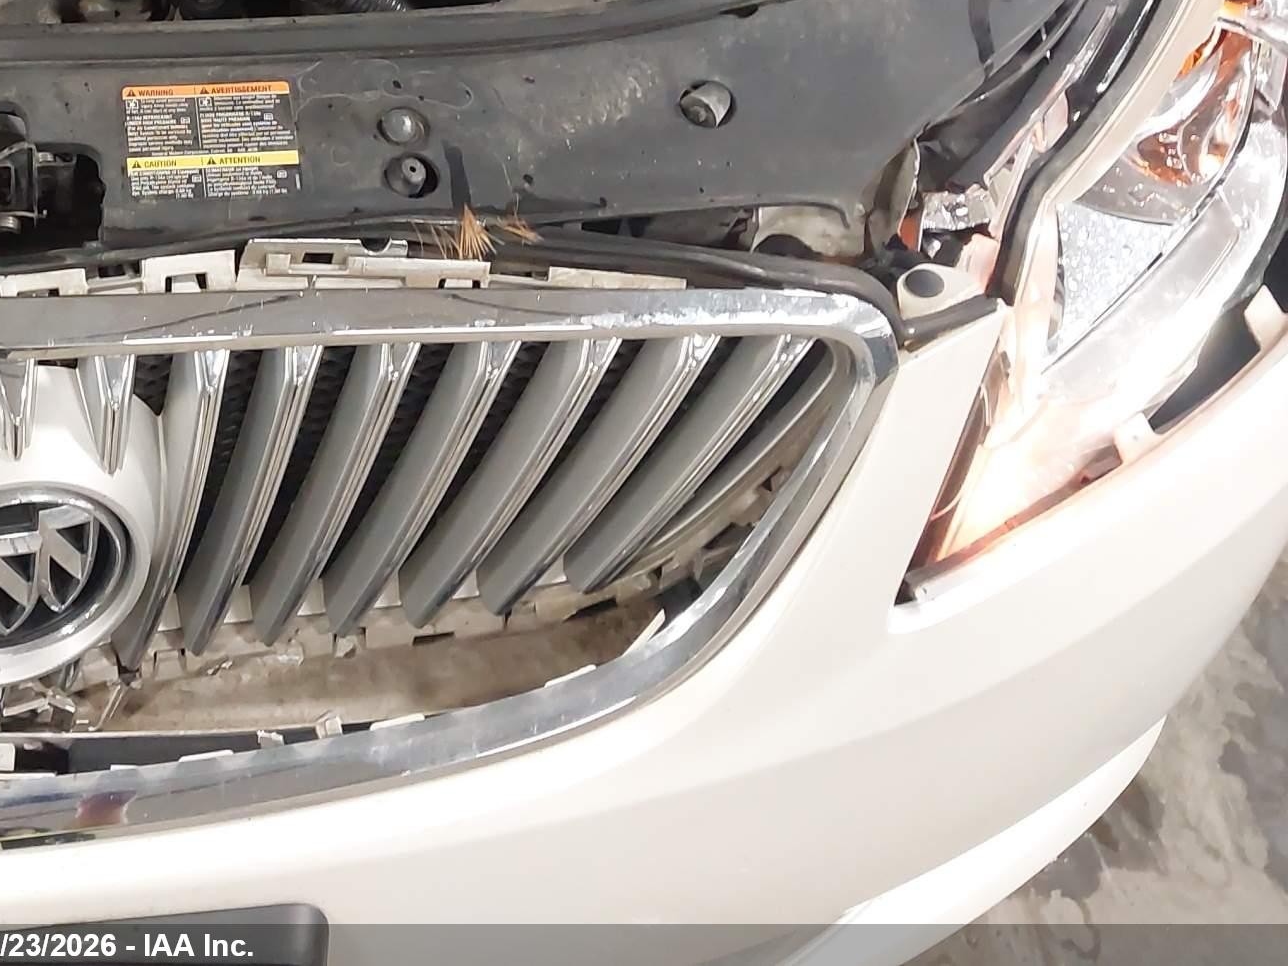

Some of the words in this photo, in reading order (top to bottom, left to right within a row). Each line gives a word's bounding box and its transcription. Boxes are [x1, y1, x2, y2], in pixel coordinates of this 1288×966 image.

[138, 88, 174, 97] WARNING
[211, 85, 273, 94] AVERTISSEMENT
[144, 159, 177, 168] CAUTION
[219, 156, 261, 165] ATTENTION
